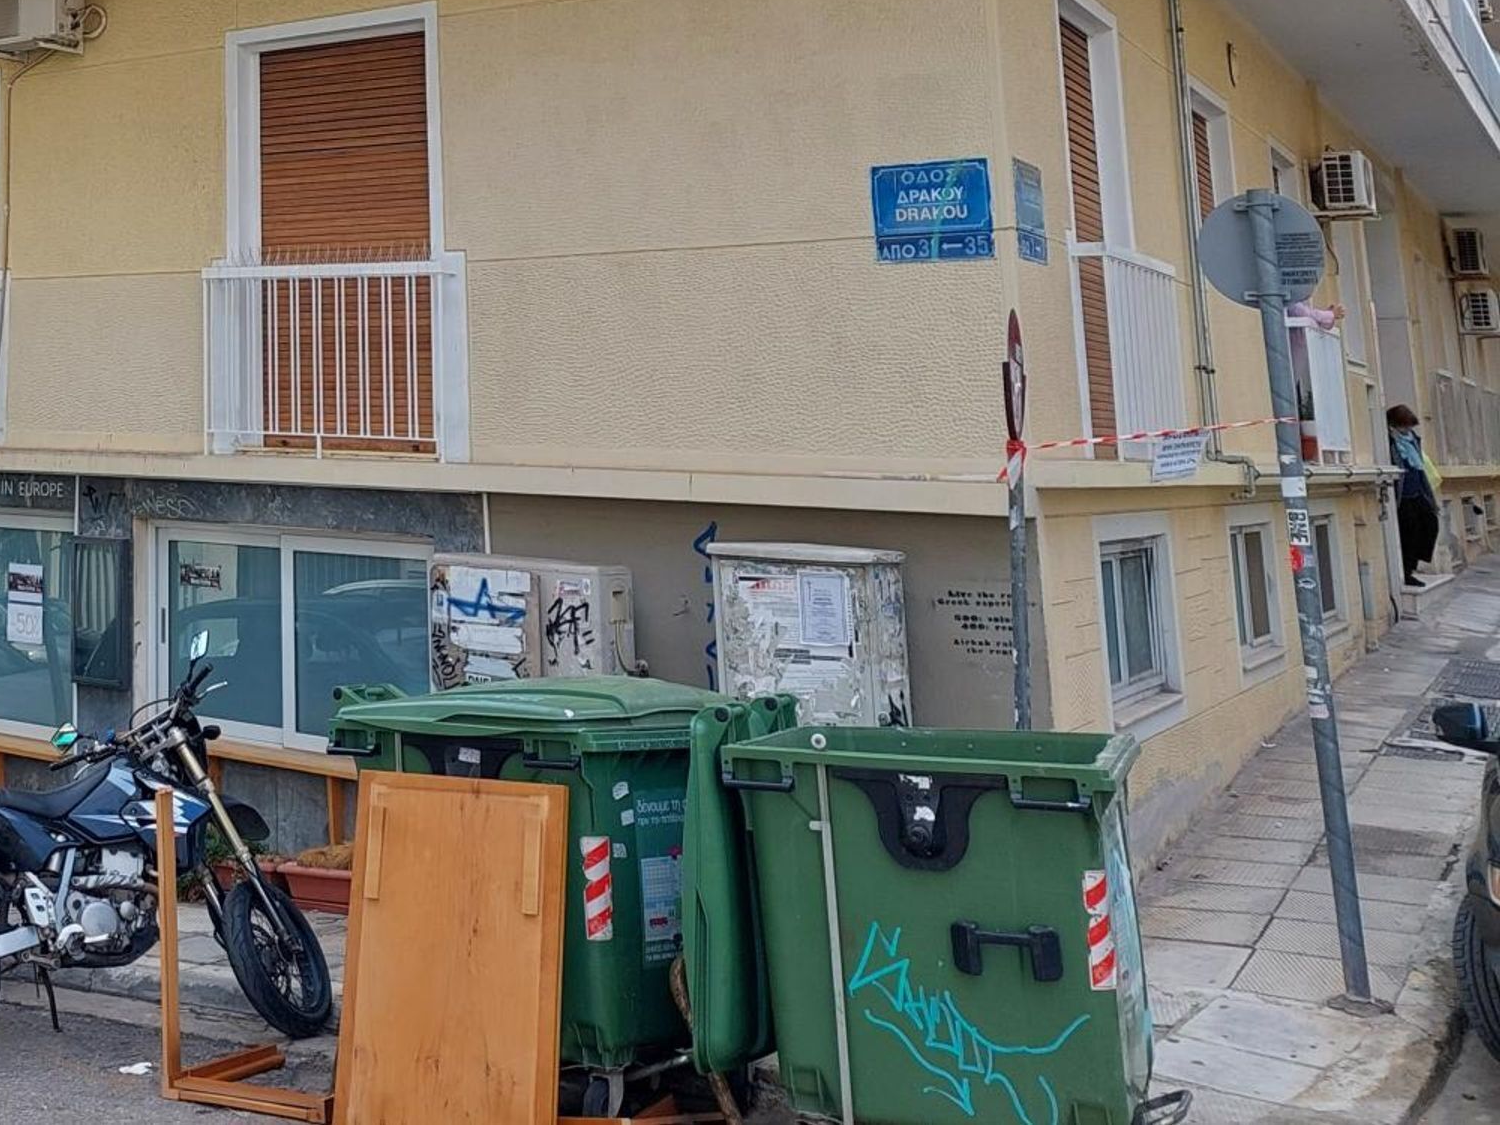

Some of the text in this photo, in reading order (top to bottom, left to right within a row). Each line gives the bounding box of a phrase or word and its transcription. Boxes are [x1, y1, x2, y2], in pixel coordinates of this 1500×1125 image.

[896, 186, 964, 205] ΔΡΑΚΟΥ
[895, 204, 968, 222] DRAKOU
[964, 234, 989, 255] 35
[1, 480, 14, 495] IN
[19, 481, 64, 498] EUROPE
